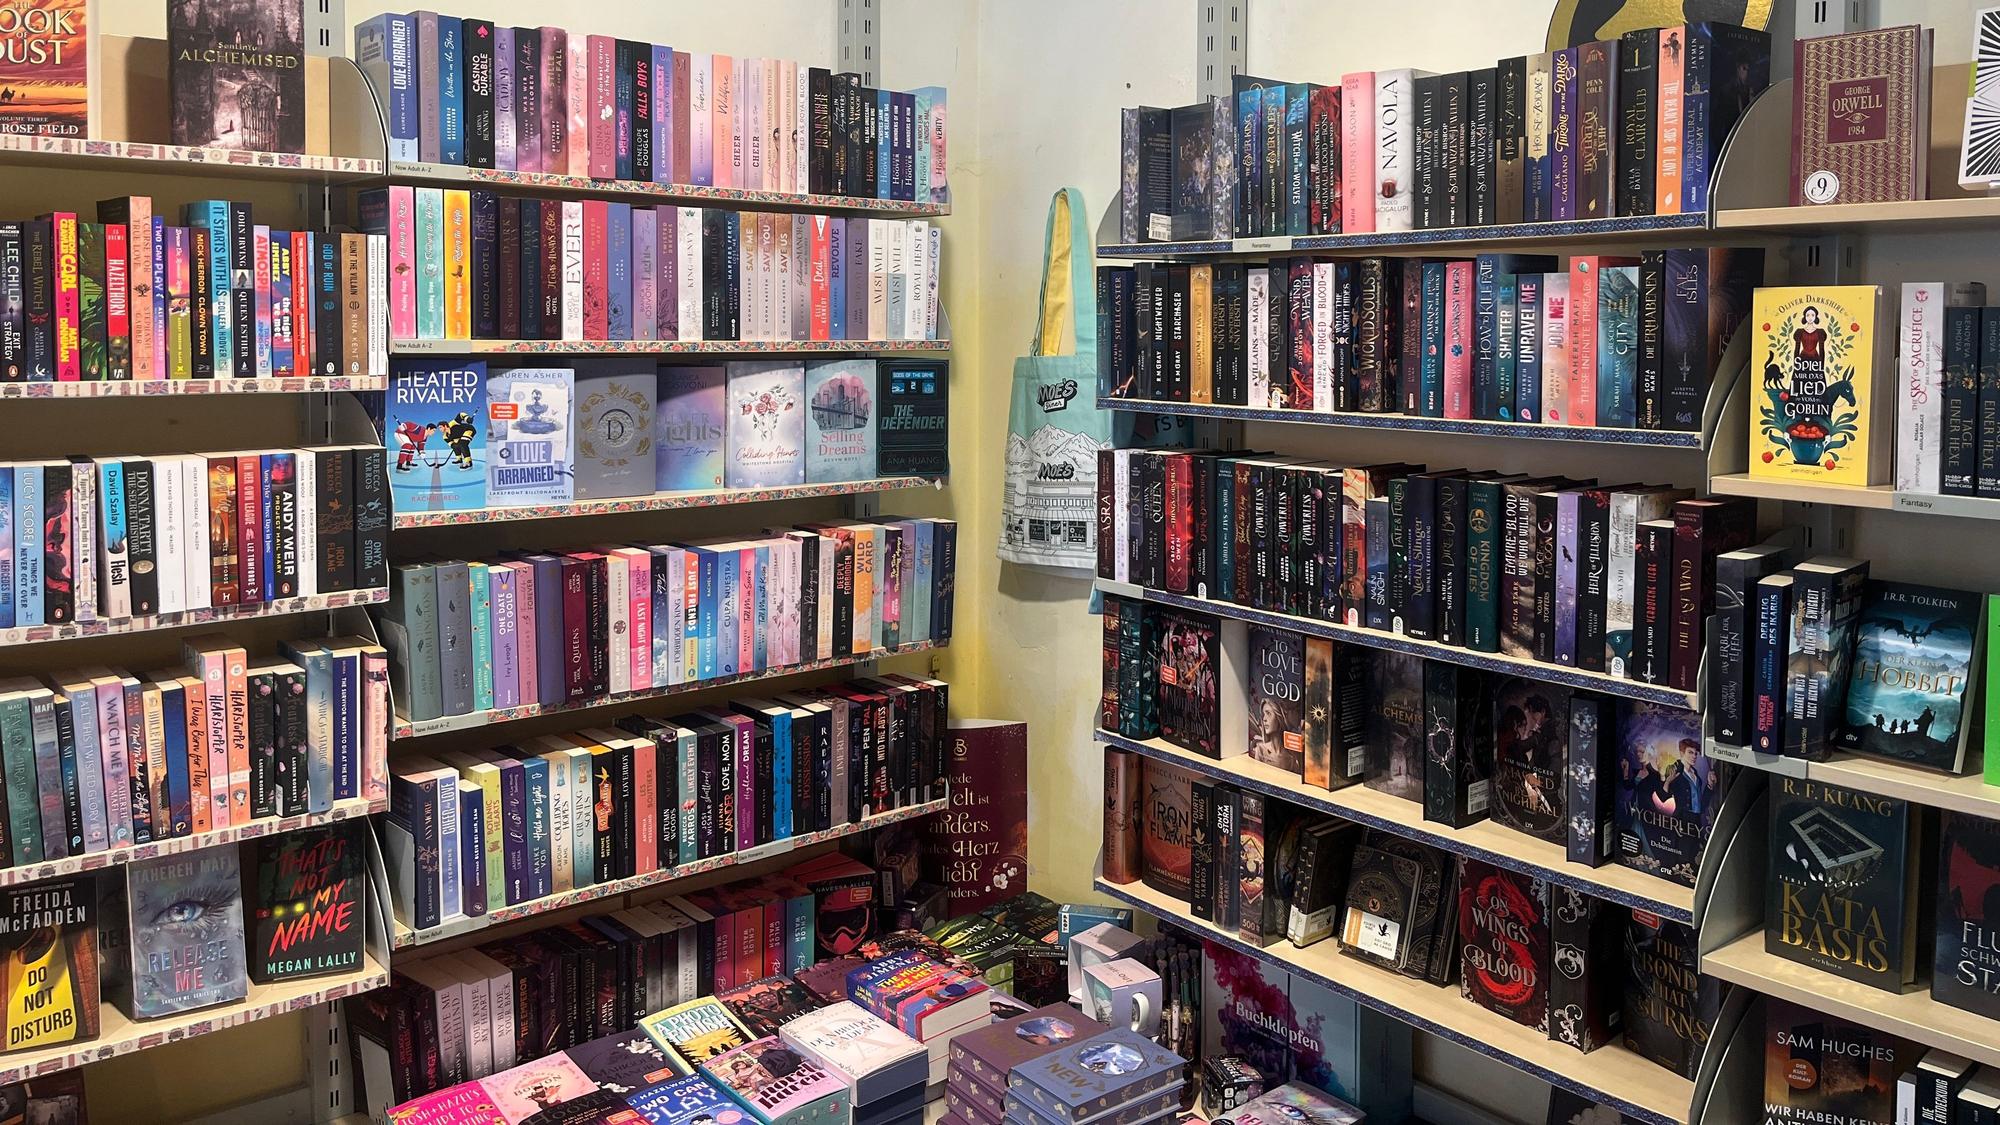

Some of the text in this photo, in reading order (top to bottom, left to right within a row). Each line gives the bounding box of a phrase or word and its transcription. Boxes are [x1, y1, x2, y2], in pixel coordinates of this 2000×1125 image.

[0, 8, 76, 35] OOK
[0, 39, 68, 64] UST
[392, 20, 406, 66] ARRANGED
[179, 49, 298, 69] ALCHEMISED
[472, 54, 480, 93] CASINO
[480, 52, 488, 97] DURABLE
[637, 61, 648, 119] FALLS BOYS
[1832, 95, 1882, 113] ORWELL
[1845, 86, 1870, 94] GEORGE
[2, 124, 78, 134] ROSE FIELD
[1382, 79, 1398, 169] NAVOLA
[1848, 126, 1865, 135] 1984
[1292, 130, 1302, 204] WITCH WOLVES
[213, 218, 225, 252] STARTS
[567, 222, 580, 284] EVER
[7, 241, 20, 303] LEE CHILD
[197, 256, 205, 293] HERRON
[215, 256, 225, 280] WITH
[109, 259, 125, 316] HAZELTHORN
[215, 284, 225, 297] US
[1302, 274, 1311, 320] WEAVER
[198, 297, 206, 324] CLOWN
[239, 291, 247, 319] QUEEN
[1174, 292, 1182, 340] STARCHASER
[5, 322, 13, 361] STRATEGY
[1500, 310, 1512, 359] SHATTER
[1520, 309, 1535, 363] UNRAVEL
[398, 372, 478, 387] HEATED
[397, 388, 477, 403] RIVALRY
[881, 416, 944, 430] DEFENDER
[893, 405, 914, 417] THE
[1785, 403, 1829, 419] GOBLIN
[819, 444, 866, 455] Dreams
[822, 431, 863, 444] Selling
[513, 442, 546, 462] LOVE
[498, 468, 553, 485] ARRANGED
[24, 472, 34, 544] LUCY SCORE
[137, 471, 151, 553] DONNA TARTT
[1102, 495, 1110, 532] ASRA
[1901, 499, 1932, 509] Fantasy
[283, 492, 295, 576] ANDY WEIR
[1519, 497, 1529, 575] WE WHO WILL DIE
[110, 561, 125, 585] Flesh
[844, 555, 852, 595] FORBIDDEN
[1479, 540, 1490, 602] KINGDOM
[1377, 572, 1385, 605] SINGH
[1912, 595, 1957, 608] TOLKIEN
[688, 599, 696, 631] FRIENDS
[1769, 594, 1777, 627] IKARUS
[1262, 650, 1300, 675] LOVE
[1277, 672, 1284, 680] A
[1262, 674, 1300, 701] GOD
[1858, 661, 1961, 696] HOBBIT
[210, 695, 224, 753] HEARTSTOPPER
[231, 690, 245, 749] HEARTSTOPPER
[1713, 747, 1739, 758] Fantasy
[722, 766, 730, 791] LOVE,
[1824, 789, 1892, 817] KUANG
[953, 841, 999, 857] Herz
[13, 896, 72, 914] FREIDA
[1491, 896, 1508, 912] ON
[1783, 881, 1885, 940] KATA
[270, 901, 356, 957] NAME
[1472, 907, 1529, 946] WINGS
[1779, 912, 1888, 973] BASIS
[28, 967, 47, 986] DO
[267, 952, 356, 974] MEGAN LALLY
[1464, 944, 1537, 987] BLOOD
[176, 968, 204, 992] ME
[24, 990, 53, 1015] NOT
[12, 1008, 73, 1044] DISTURB
[657, 1023, 667, 1033] A
[1236, 1001, 1319, 1051] Buchklopfen
[1776, 1032, 1894, 1061] SAM HUGHES
[1766, 1103, 1843, 1124] WIR HABEN
